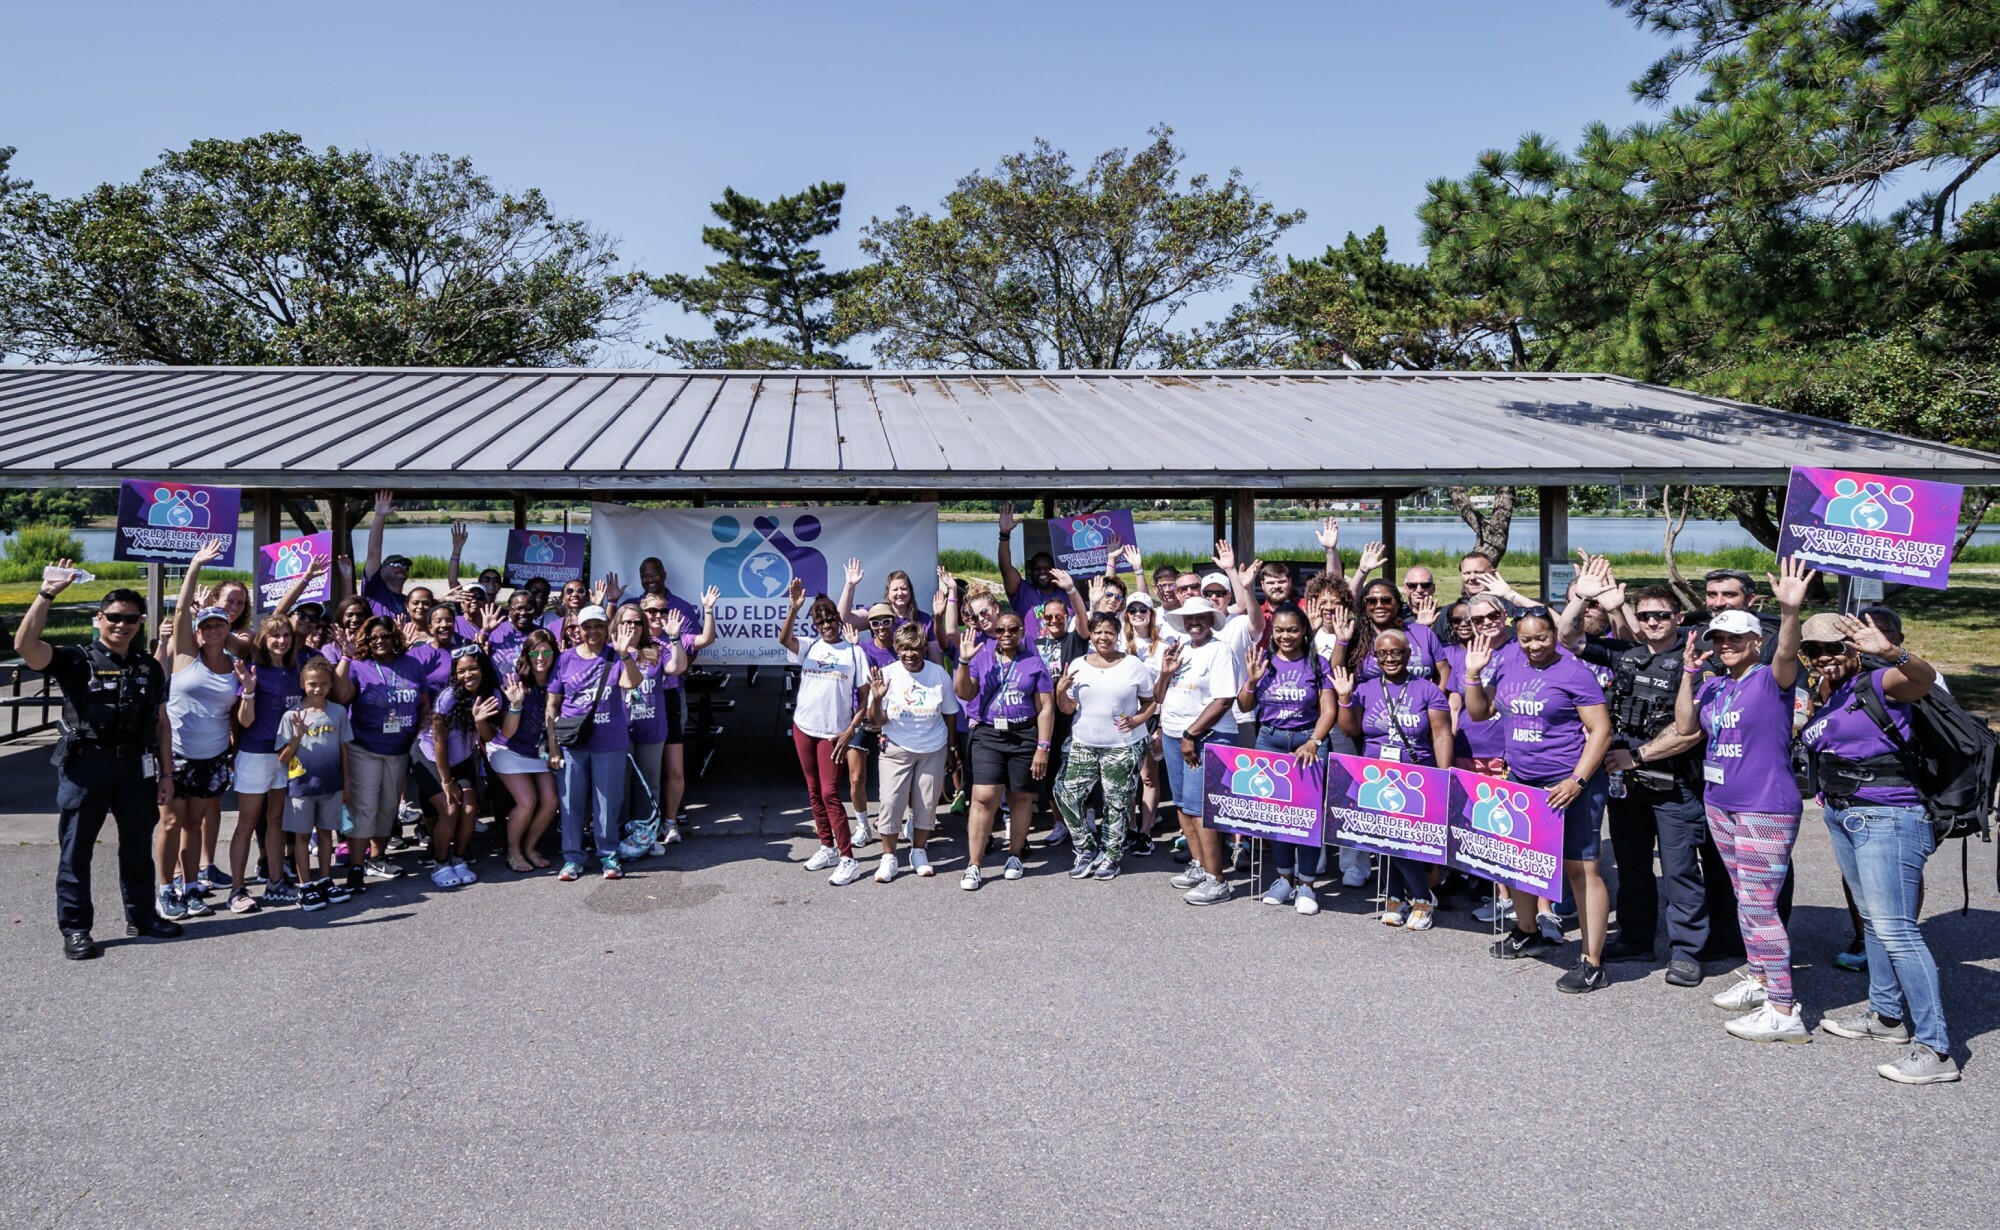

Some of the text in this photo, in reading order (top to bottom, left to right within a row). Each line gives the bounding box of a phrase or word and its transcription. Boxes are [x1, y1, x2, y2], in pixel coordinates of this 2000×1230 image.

[122, 527, 164, 539] WORLD
[165, 530, 198, 541] ELDER
[143, 538, 205, 550] AWARENES
[1789, 524, 1945, 557] WORLD ELDER ABUSE
[1058, 550, 1087, 563] WORLD
[1818, 541, 1940, 568] AWARENESS DAY
[743, 604, 800, 620] ELDE
[722, 646, 753, 660] Strong
[758, 646, 787, 660] Supp
[1652, 677, 1669, 689] 72C
[1275, 688, 1307, 701] STOP
[1510, 699, 1544, 717] STOP
[1512, 727, 1543, 743] ABUSE
[1805, 718, 1828, 745] STOP
[1208, 793, 1316, 819] WORLD ELDER ABUSE
[1229, 807, 1291, 825] AWARENESS
[1292, 816, 1314, 829] DAY
[1331, 806, 1376, 822] WORLD
[1376, 814, 1411, 829] ELDER
[1353, 820, 1423, 842] AWARENESS
[1424, 833, 1447, 847] DAY
[1450, 825, 1488, 846] WORLD
[1487, 837, 1519, 857] ELDER
[1520, 847, 1557, 868] ABUSE
[1470, 843, 1531, 872] AWARENESS
[1530, 863, 1554, 879] DAY
